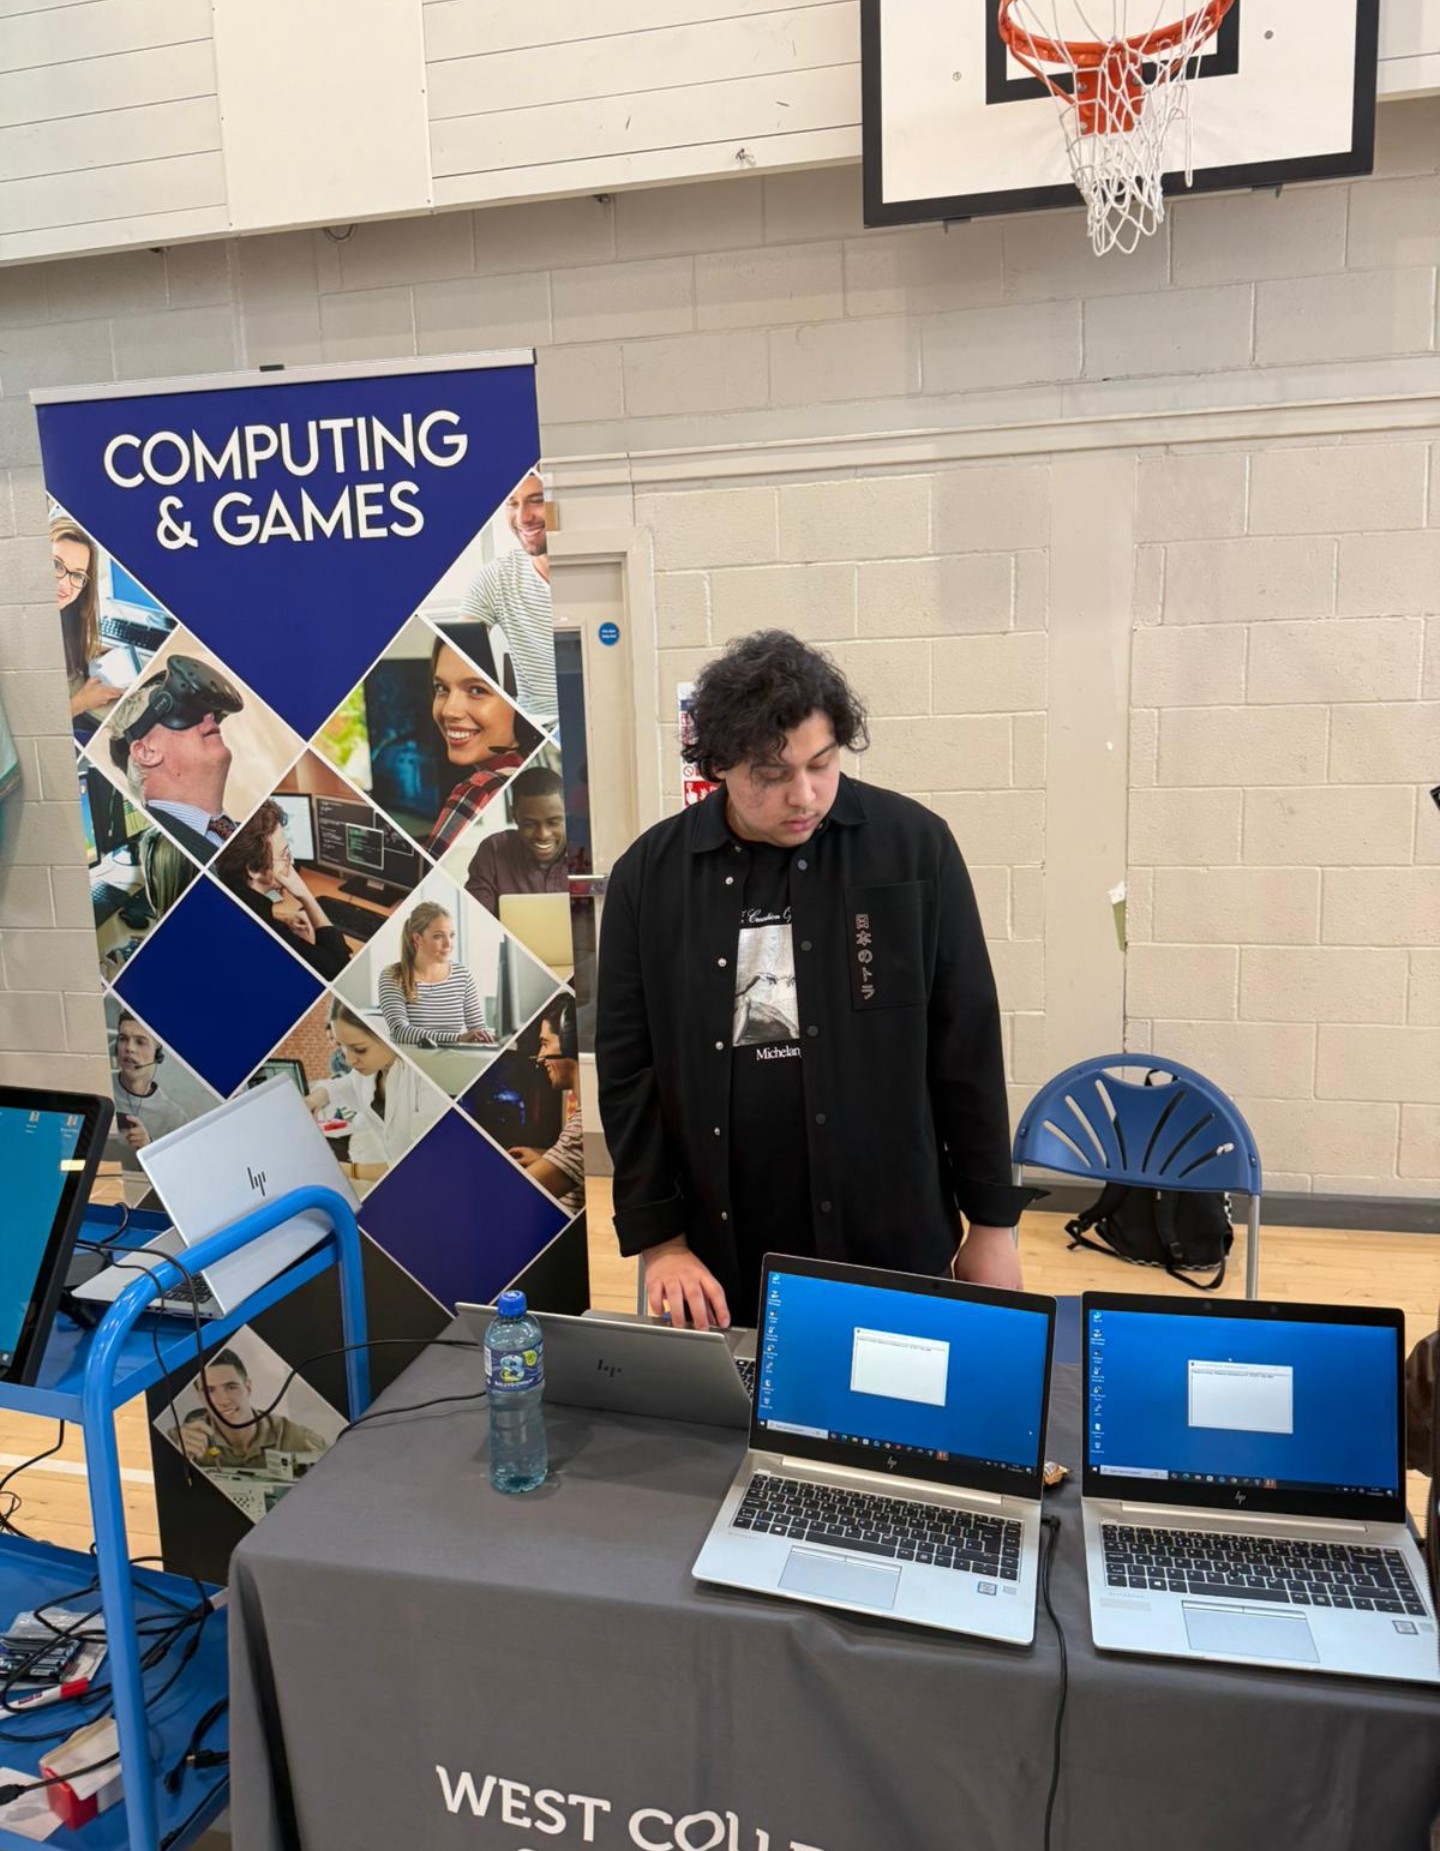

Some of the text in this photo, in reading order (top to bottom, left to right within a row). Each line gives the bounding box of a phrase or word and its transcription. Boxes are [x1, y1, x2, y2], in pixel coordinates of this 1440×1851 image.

[103, 410, 468, 488] COMPUTING
[156, 480, 425, 550] & GAMES
[756, 1045, 802, 1061] Michelan
[247, 1166, 266, 1197] hp
[435, 1764, 826, 1851] WEST COL
